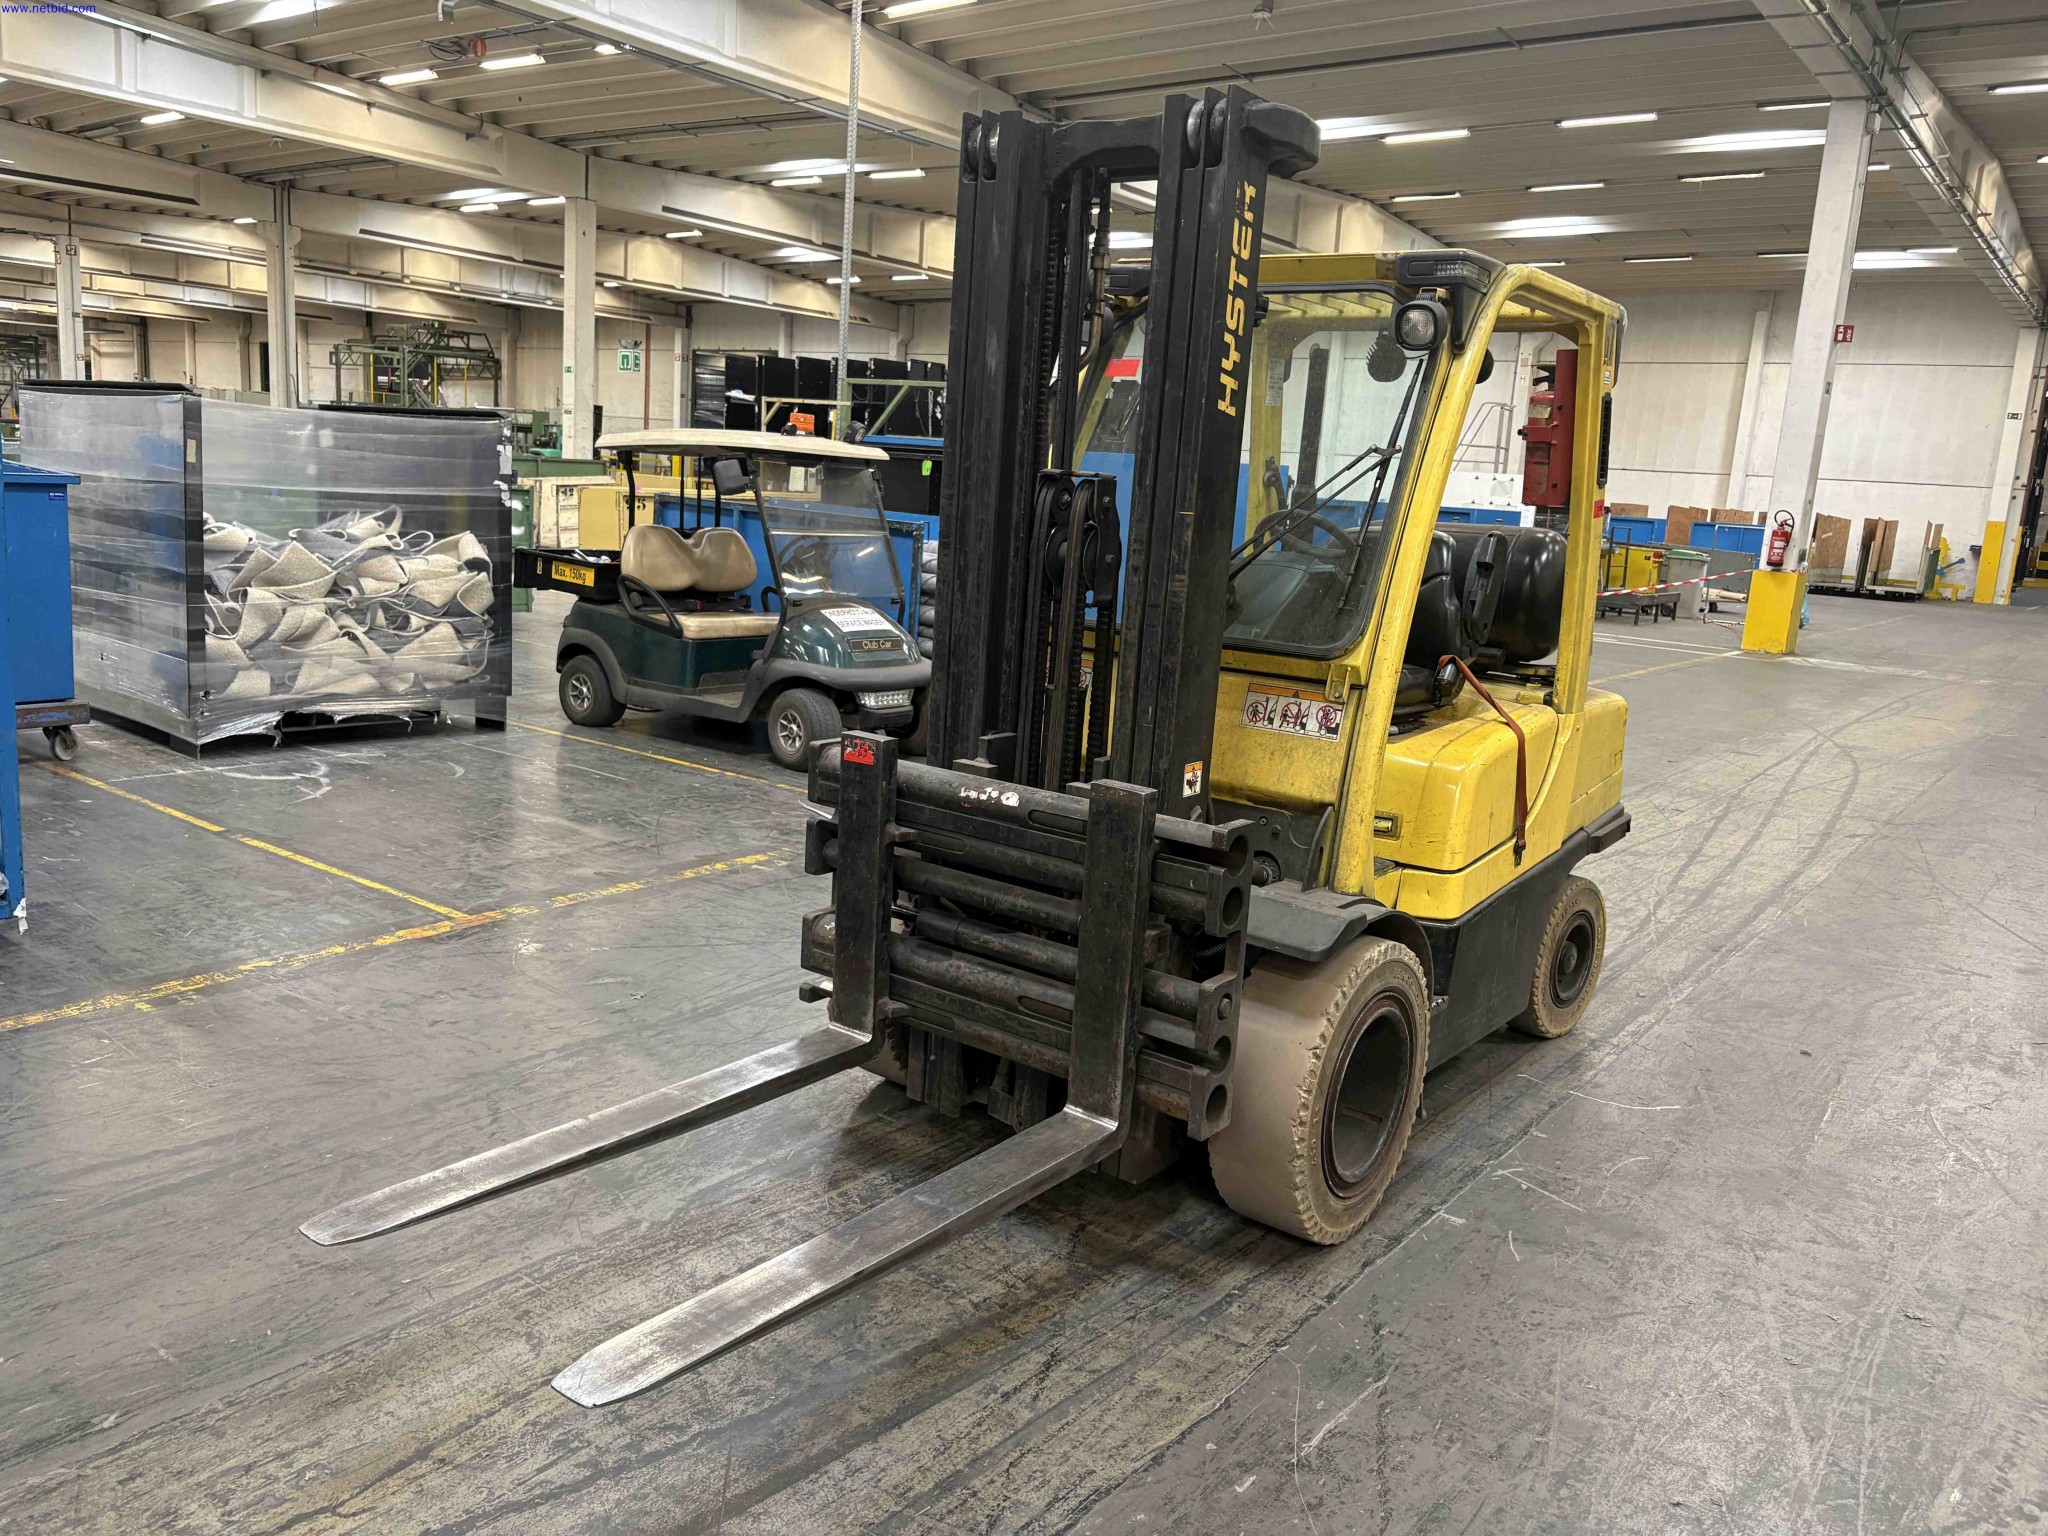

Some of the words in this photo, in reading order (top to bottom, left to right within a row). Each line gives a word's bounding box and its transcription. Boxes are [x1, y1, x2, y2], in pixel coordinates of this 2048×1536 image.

[1217, 180, 1257, 417] HYSTER
[554, 564, 568, 578] Max.
[569, 567, 587, 585] 150kg
[862, 640, 879, 649] Club
[879, 640, 892, 648] Car
